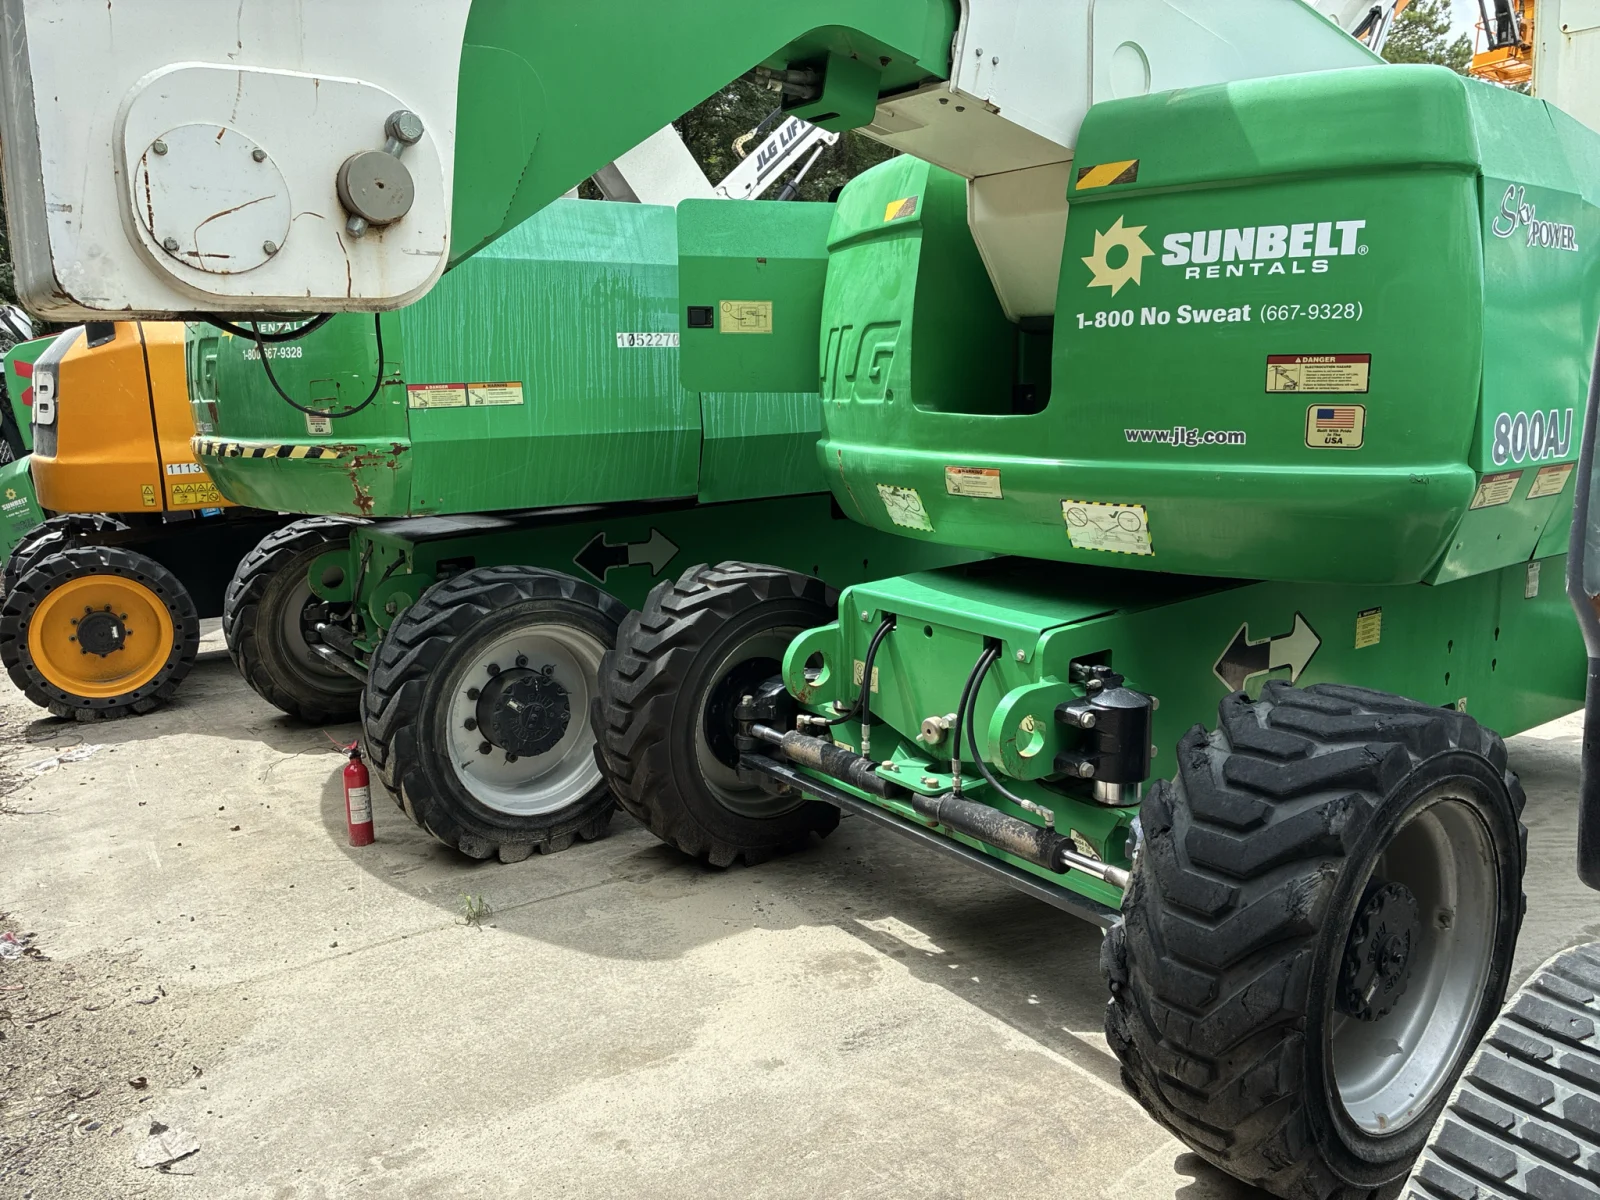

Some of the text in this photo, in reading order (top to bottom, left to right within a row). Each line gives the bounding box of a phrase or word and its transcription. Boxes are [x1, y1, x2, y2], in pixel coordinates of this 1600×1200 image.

[756, 139, 778, 173] JLG
[1492, 184, 1575, 250] Sky POWER
[1161, 219, 1366, 266] SUNBELT
[1185, 259, 1329, 280] RENTALS
[258, 321, 309, 333] ENTAL
[1076, 301, 1364, 329] 1-800 No Sweat (667-9328)
[32, 371, 55, 425] B
[1124, 426, 1246, 447] www.jlg.com
[1492, 408, 1573, 466] 800AJ
[168, 462, 205, 474] 1113
